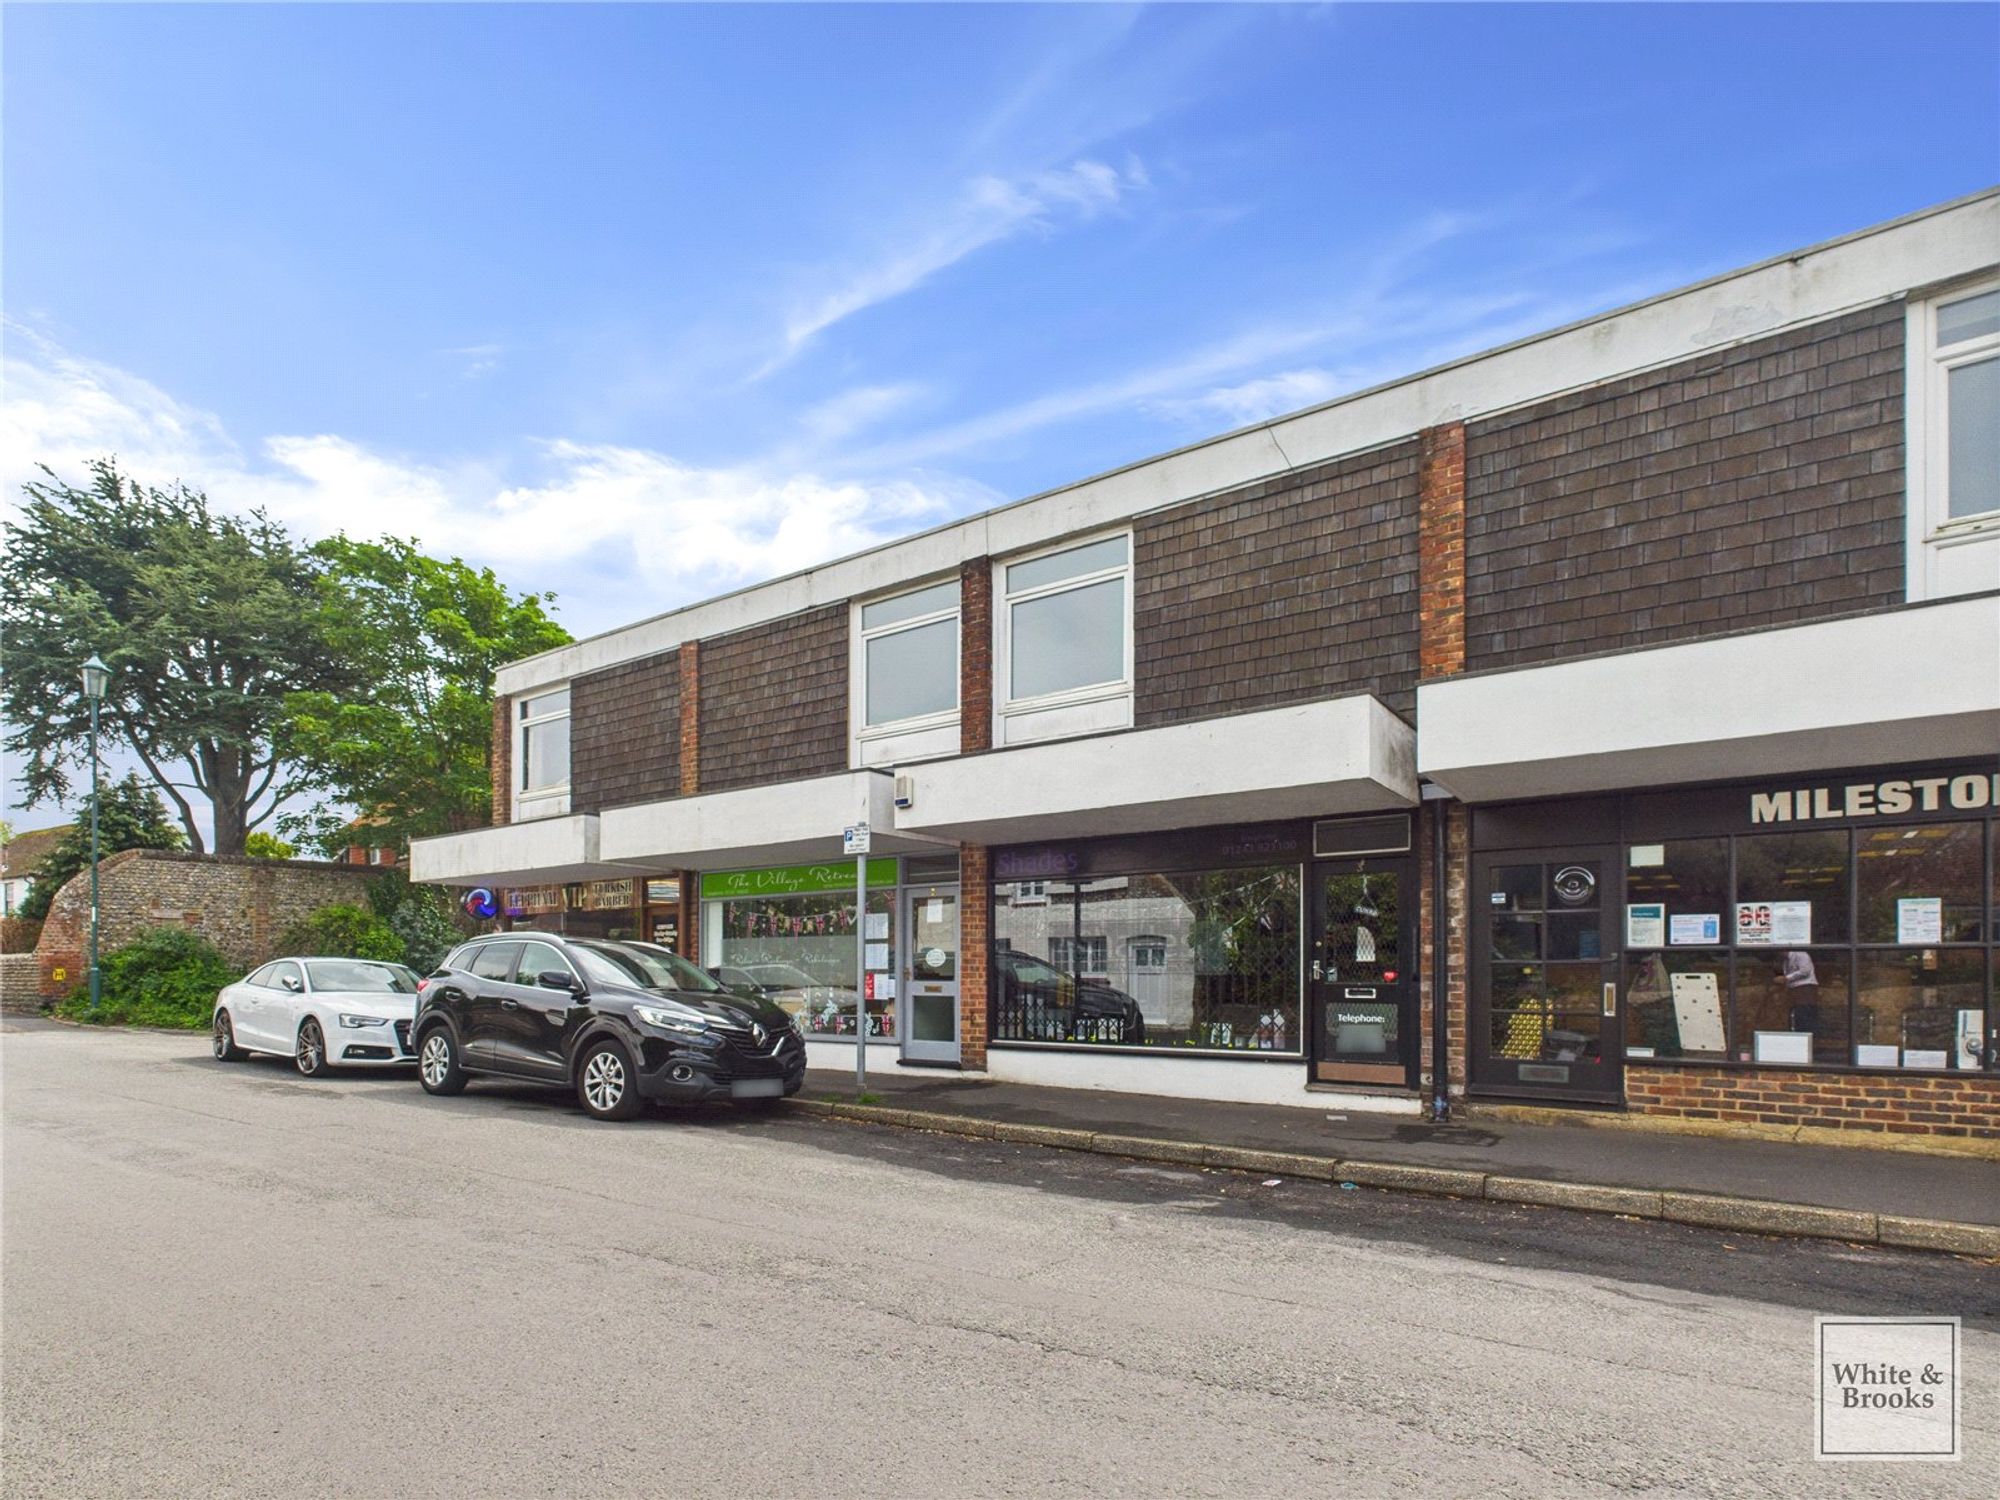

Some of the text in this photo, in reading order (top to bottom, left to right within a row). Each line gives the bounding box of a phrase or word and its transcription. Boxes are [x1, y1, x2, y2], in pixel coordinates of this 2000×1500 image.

[1751, 774, 2000, 824] MILESTO
[998, 847, 1077, 874] Shades
[594, 880, 632, 893] TURKISH
[728, 873, 749, 888] The
[757, 871, 803, 891] Village
[809, 866, 858, 882] Retrea
[562, 886, 588, 911] VIP
[1337, 1013, 1385, 1024] Telephone:
